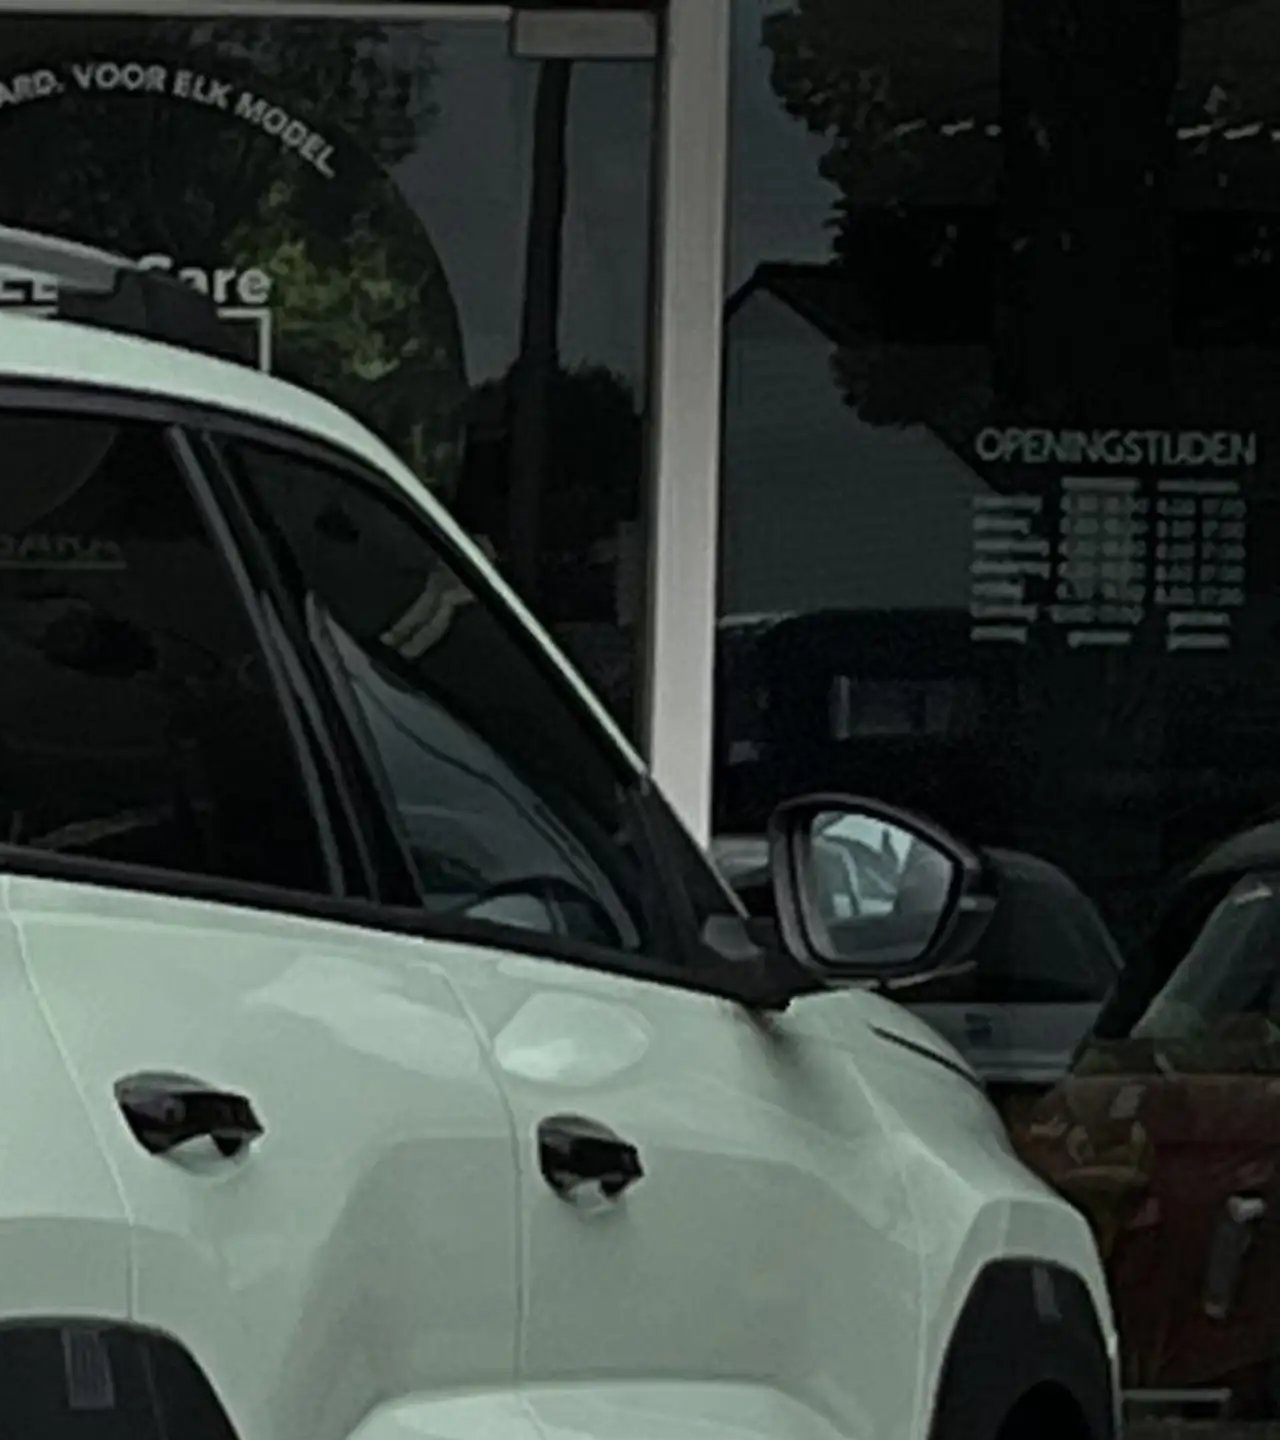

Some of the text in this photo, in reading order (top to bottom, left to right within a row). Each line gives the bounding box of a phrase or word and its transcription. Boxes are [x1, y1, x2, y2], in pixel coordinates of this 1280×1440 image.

[72, 63, 165, 93] VOOR
[172, 70, 232, 109] ELK
[235, 92, 336, 178] MODEL
